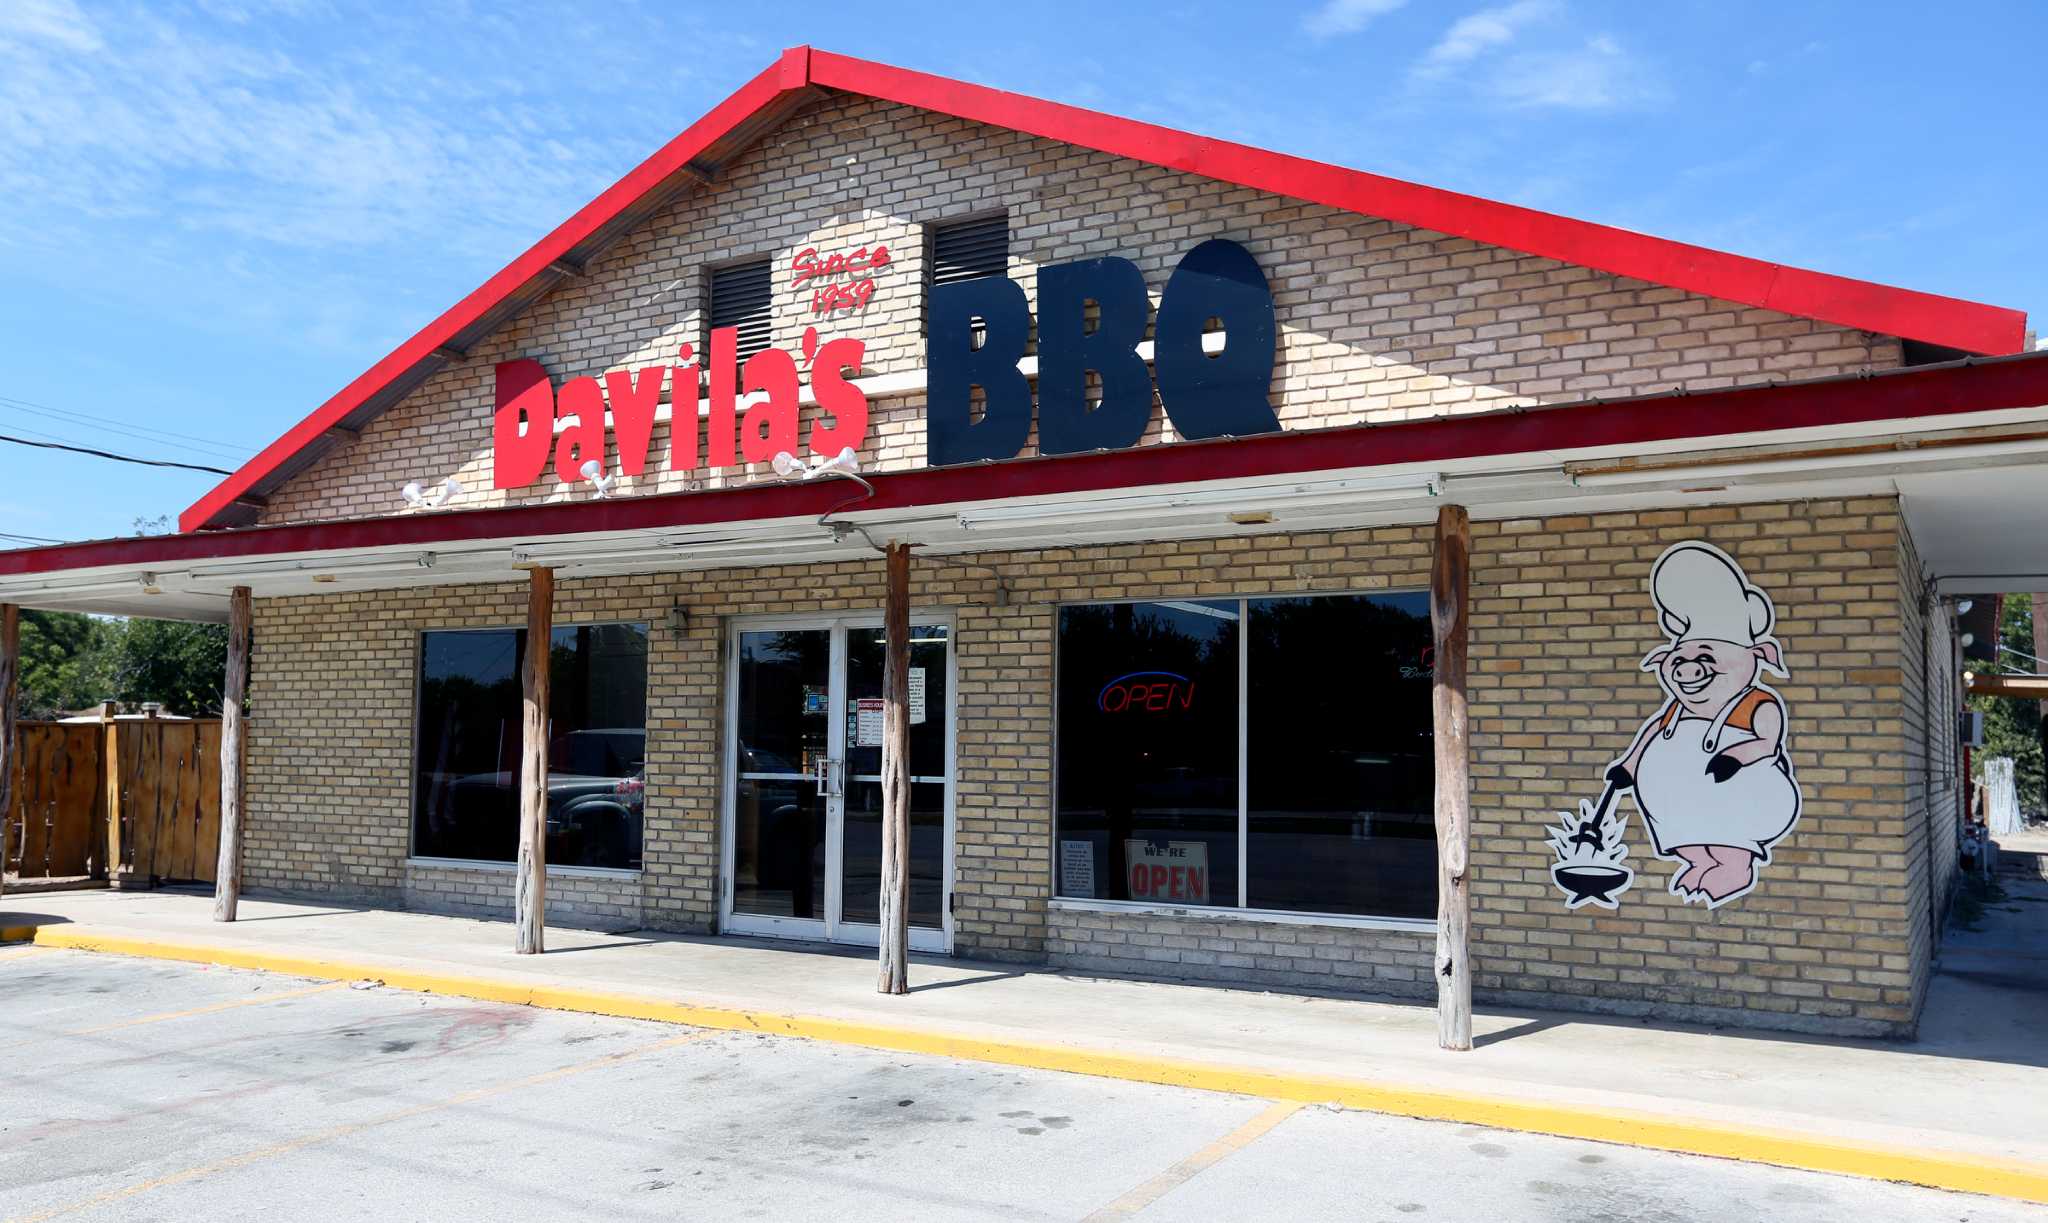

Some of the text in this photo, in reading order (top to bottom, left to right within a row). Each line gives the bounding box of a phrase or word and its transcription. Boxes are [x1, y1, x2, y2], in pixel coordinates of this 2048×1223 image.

[791, 246, 891, 288] Since
[811, 278, 874, 315] 1959
[494, 238, 1282, 490] Davila's BBQ
[1103, 682, 1196, 712] OPEN
[1144, 846, 1188, 858] WE'RE
[1132, 862, 1204, 898] OPEN
